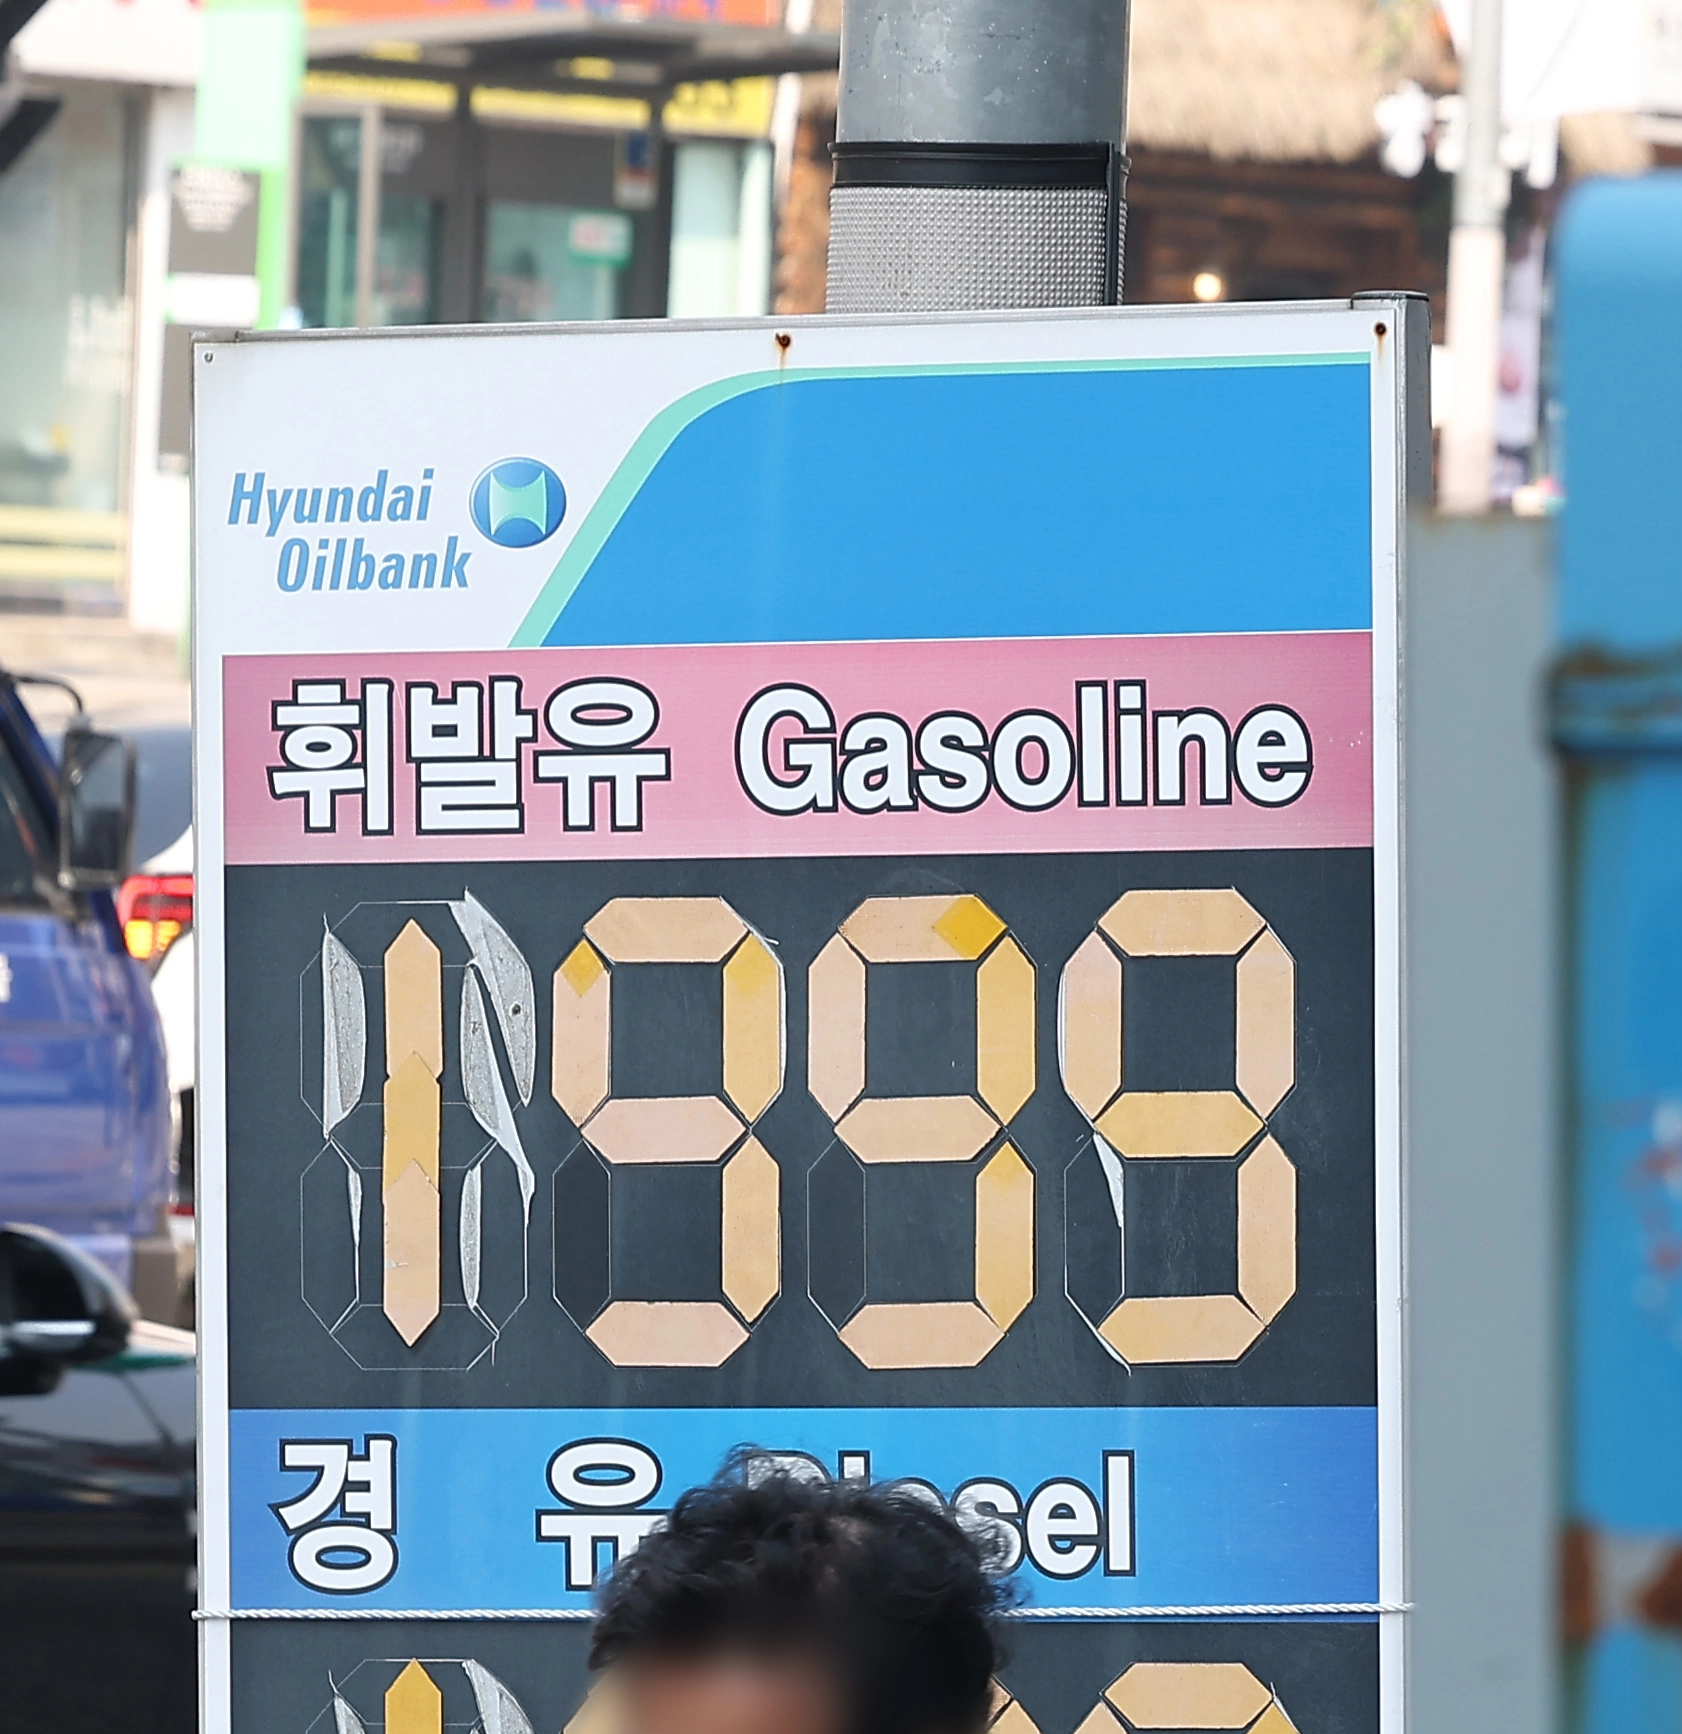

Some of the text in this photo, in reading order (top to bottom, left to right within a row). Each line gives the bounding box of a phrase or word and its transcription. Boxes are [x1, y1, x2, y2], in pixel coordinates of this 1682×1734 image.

[227, 467, 435, 537] Hyundai
[277, 535, 473, 593] Oilbank
[267, 675, 1313, 835] 휘발유 Gasoline
[382, 887, 1297, 1370] 1999
